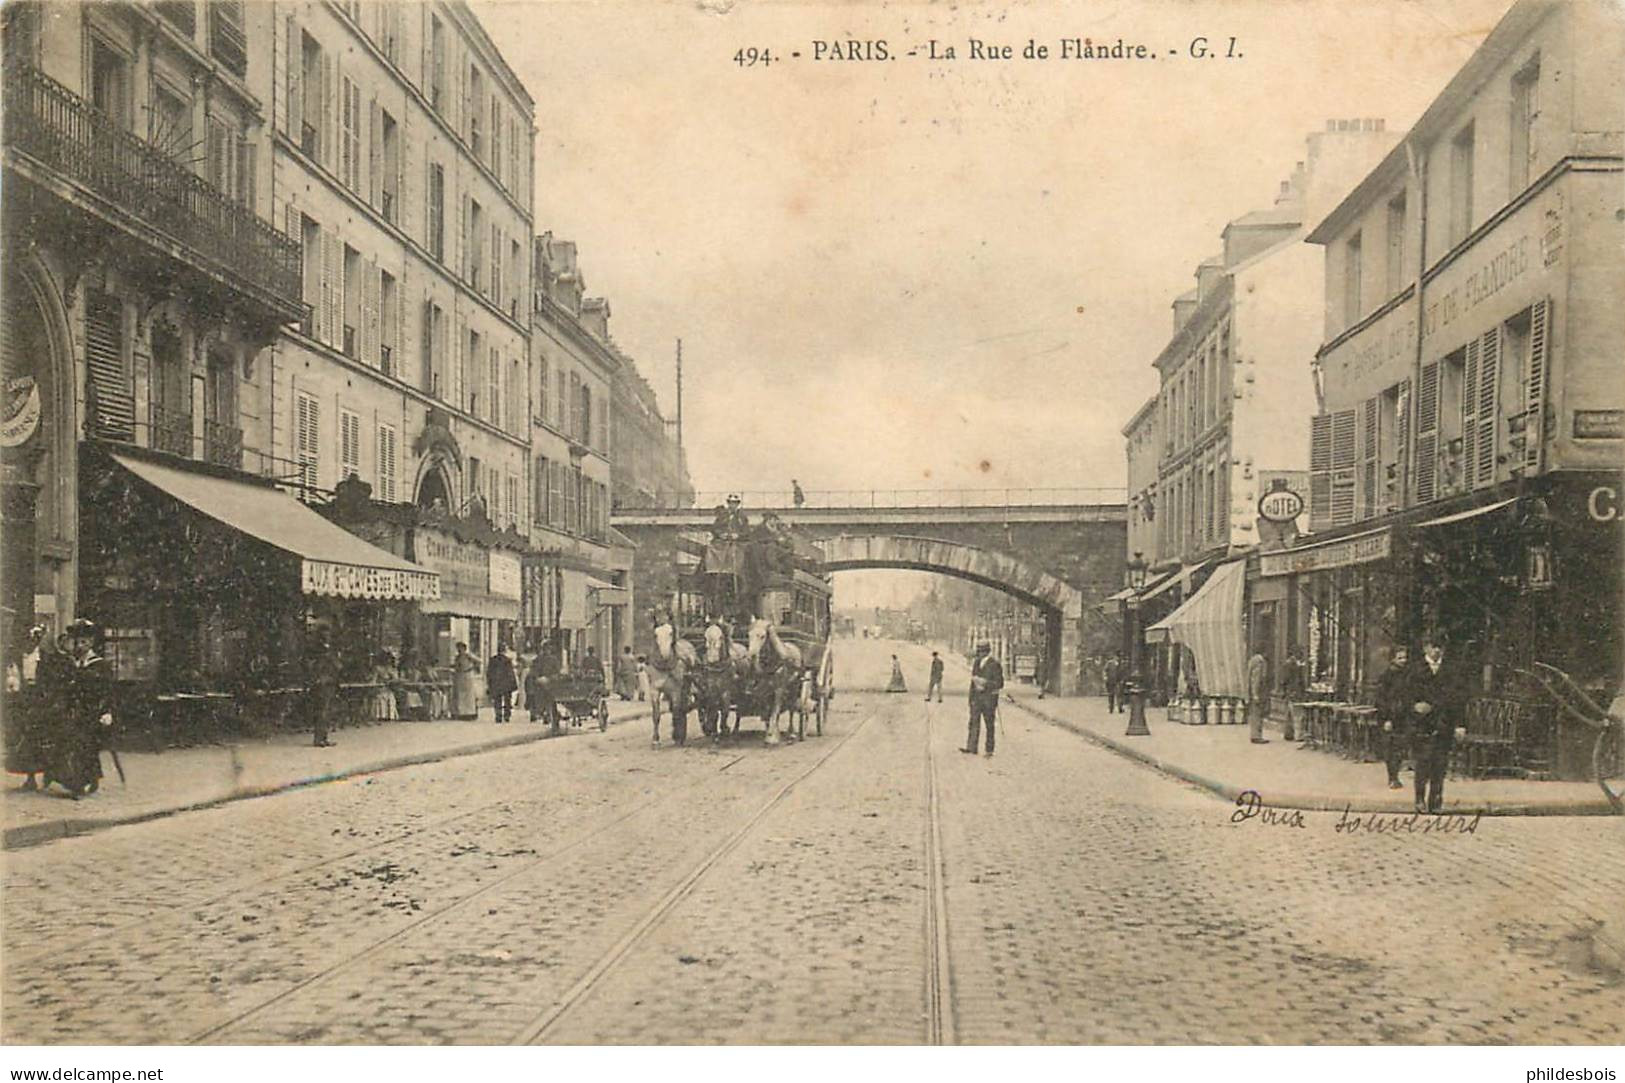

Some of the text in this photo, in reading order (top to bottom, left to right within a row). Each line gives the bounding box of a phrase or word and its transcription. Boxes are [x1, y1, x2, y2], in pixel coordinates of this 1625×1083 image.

[1407, 303, 1439, 350] PNT
[1443, 288, 1458, 325] DE
[1464, 235, 1529, 312] FLANDRE
[308, 562, 330, 590] AUX
